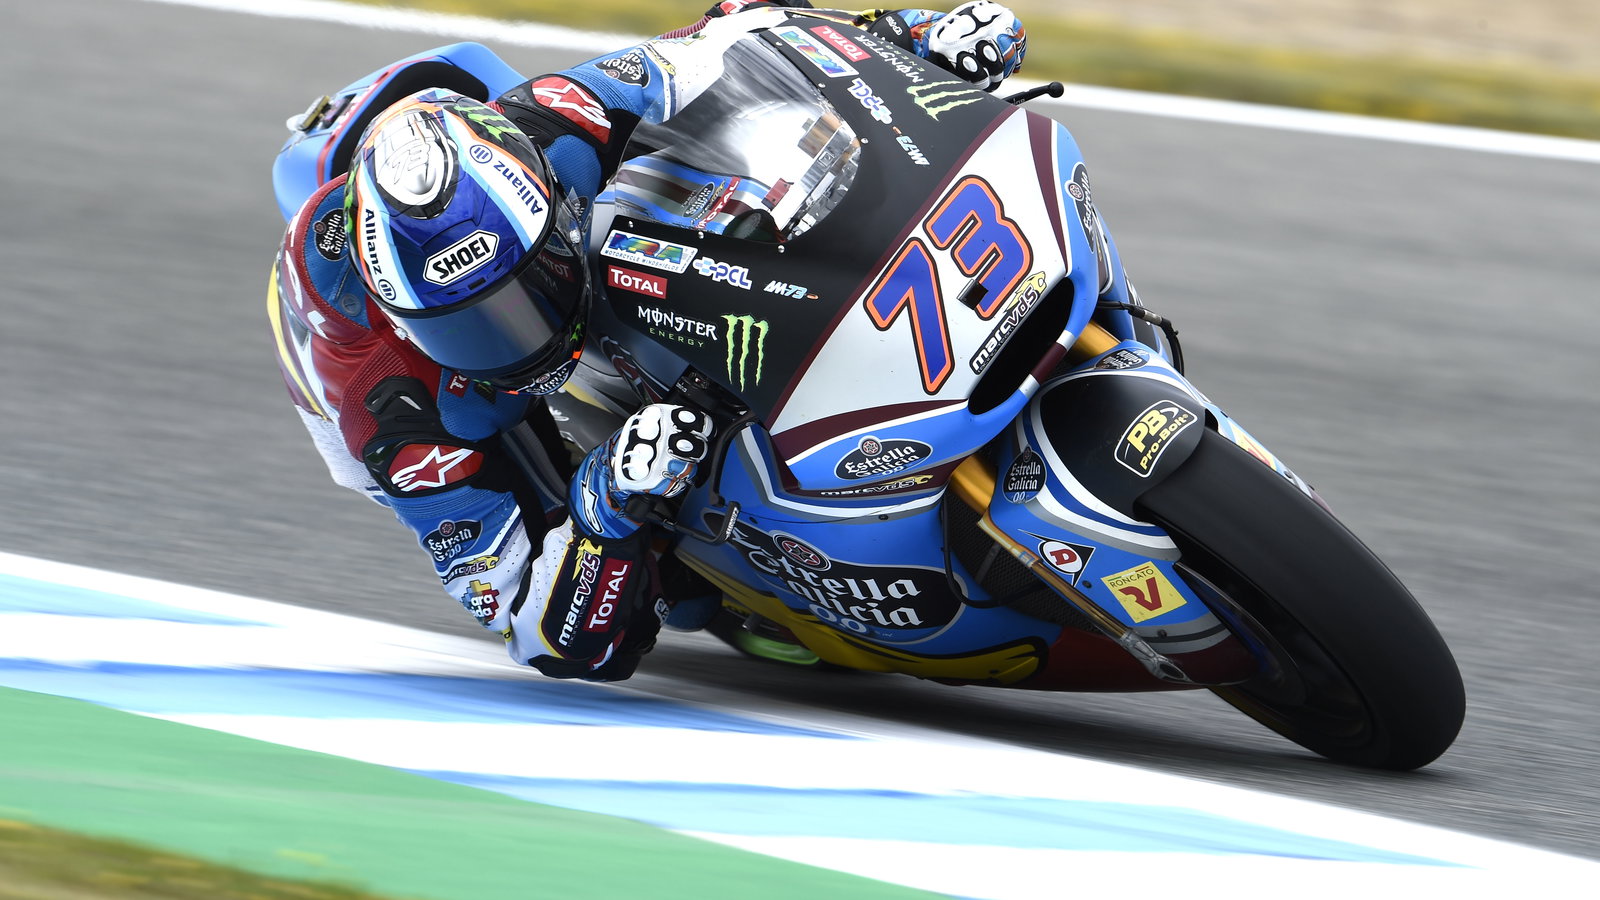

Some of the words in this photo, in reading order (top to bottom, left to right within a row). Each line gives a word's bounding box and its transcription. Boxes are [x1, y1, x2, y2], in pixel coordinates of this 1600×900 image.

[822, 27, 863, 60] TOTAL
[854, 35, 924, 83] MONSTER
[602, 57, 642, 81] Estrell
[850, 79, 880, 110] PCL
[493, 160, 544, 216] Allianz
[318, 213, 342, 252] Estrella
[365, 208, 383, 275] Allianz
[608, 232, 683, 265] MRA
[432, 236, 491, 280] SHOEI
[610, 268, 664, 295] TOTAL
[713, 262, 751, 288] PCL
[863, 174, 1034, 396] 73
[637, 305, 718, 341] MONSTER
[649, 327, 704, 348] ENERGY
[971, 285, 1038, 371] marcvds
[1126, 409, 1168, 453] PB
[844, 445, 916, 474] Estrella
[855, 454, 920, 478] Galicia
[1010, 461, 1041, 477] Estrella
[820, 478, 915, 496] marcvds
[1007, 476, 1038, 491] Galicia
[1049, 548, 1078, 566] D
[1109, 567, 1155, 589] RONCATO
[558, 550, 601, 647] marcvds
[587, 564, 629, 629] TOTAL
